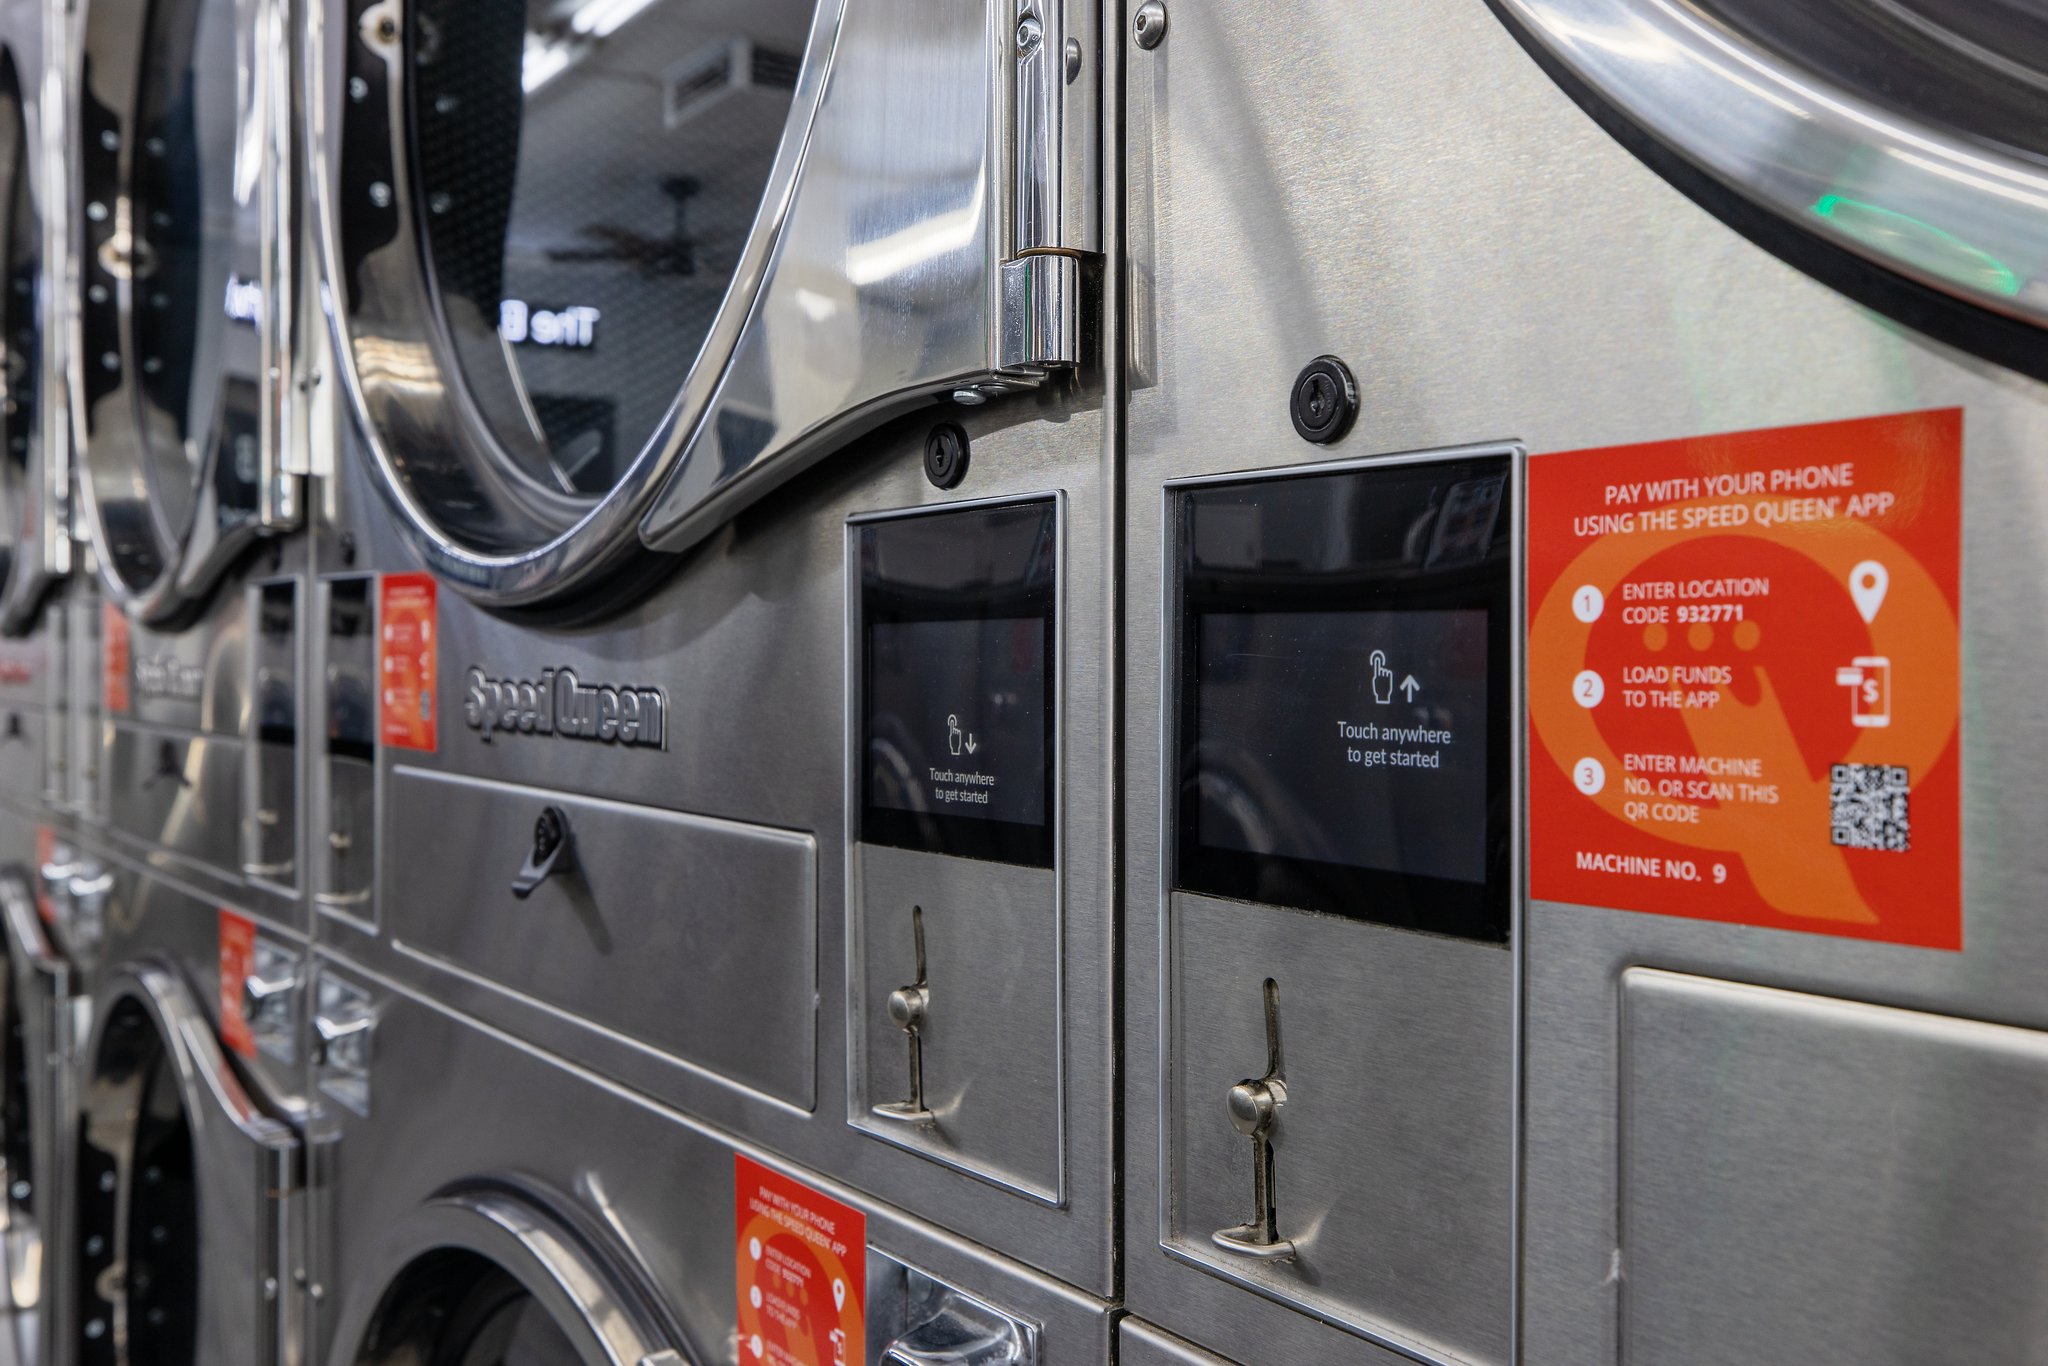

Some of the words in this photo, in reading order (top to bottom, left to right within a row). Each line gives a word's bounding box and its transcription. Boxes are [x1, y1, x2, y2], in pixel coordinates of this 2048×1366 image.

[1605, 484, 1642, 506] PAY
[1645, 478, 1699, 501] WITH
[1703, 472, 1765, 497] YOUR
[1770, 463, 1854, 490] PHONE
[1573, 513, 1635, 537] USING
[1638, 509, 1676, 532] THE
[1682, 504, 1749, 529] SPEED
[1845, 492, 1895, 518] APP
[1622, 581, 1675, 601] ENTER
[1678, 577, 1770, 599] LOCATION
[1622, 606, 1670, 624] CODE
[1676, 603, 1744, 624] 932771
[1623, 666, 1669, 684] LOAD
[1673, 666, 1733, 685] FUNDS
[1582, 679, 1594, 698] 2
[1622, 689, 1646, 708] TO
[1649, 690, 1682, 708] THE
[1685, 691, 1720, 709] APP
[1337, 721, 1378, 740] Touch
[1381, 724, 1451, 745] anywhere
[1347, 746, 1361, 762] to
[1364, 748, 1387, 767] get
[1390, 750, 1439, 768] started
[1624, 753, 1676, 773] ENTER
[1679, 756, 1762, 778] MACHINE
[929, 767, 953, 782] Touch
[955, 771, 995, 786] anywhere
[1583, 767, 1595, 786] 3
[935, 787, 944, 800] to
[945, 789, 958, 803] get
[960, 790, 988, 804] started
[1623, 778, 1654, 796] NO.
[1658, 779, 1684, 798] OR
[1687, 780, 1734, 801] SCAN
[1737, 783, 1779, 804] THIS
[1624, 801, 1648, 822] QR
[1651, 803, 1700, 824] CODE
[1576, 851, 1661, 878] MACHINE
[1665, 860, 1702, 882] NO.
[1712, 863, 1727, 884] 9
